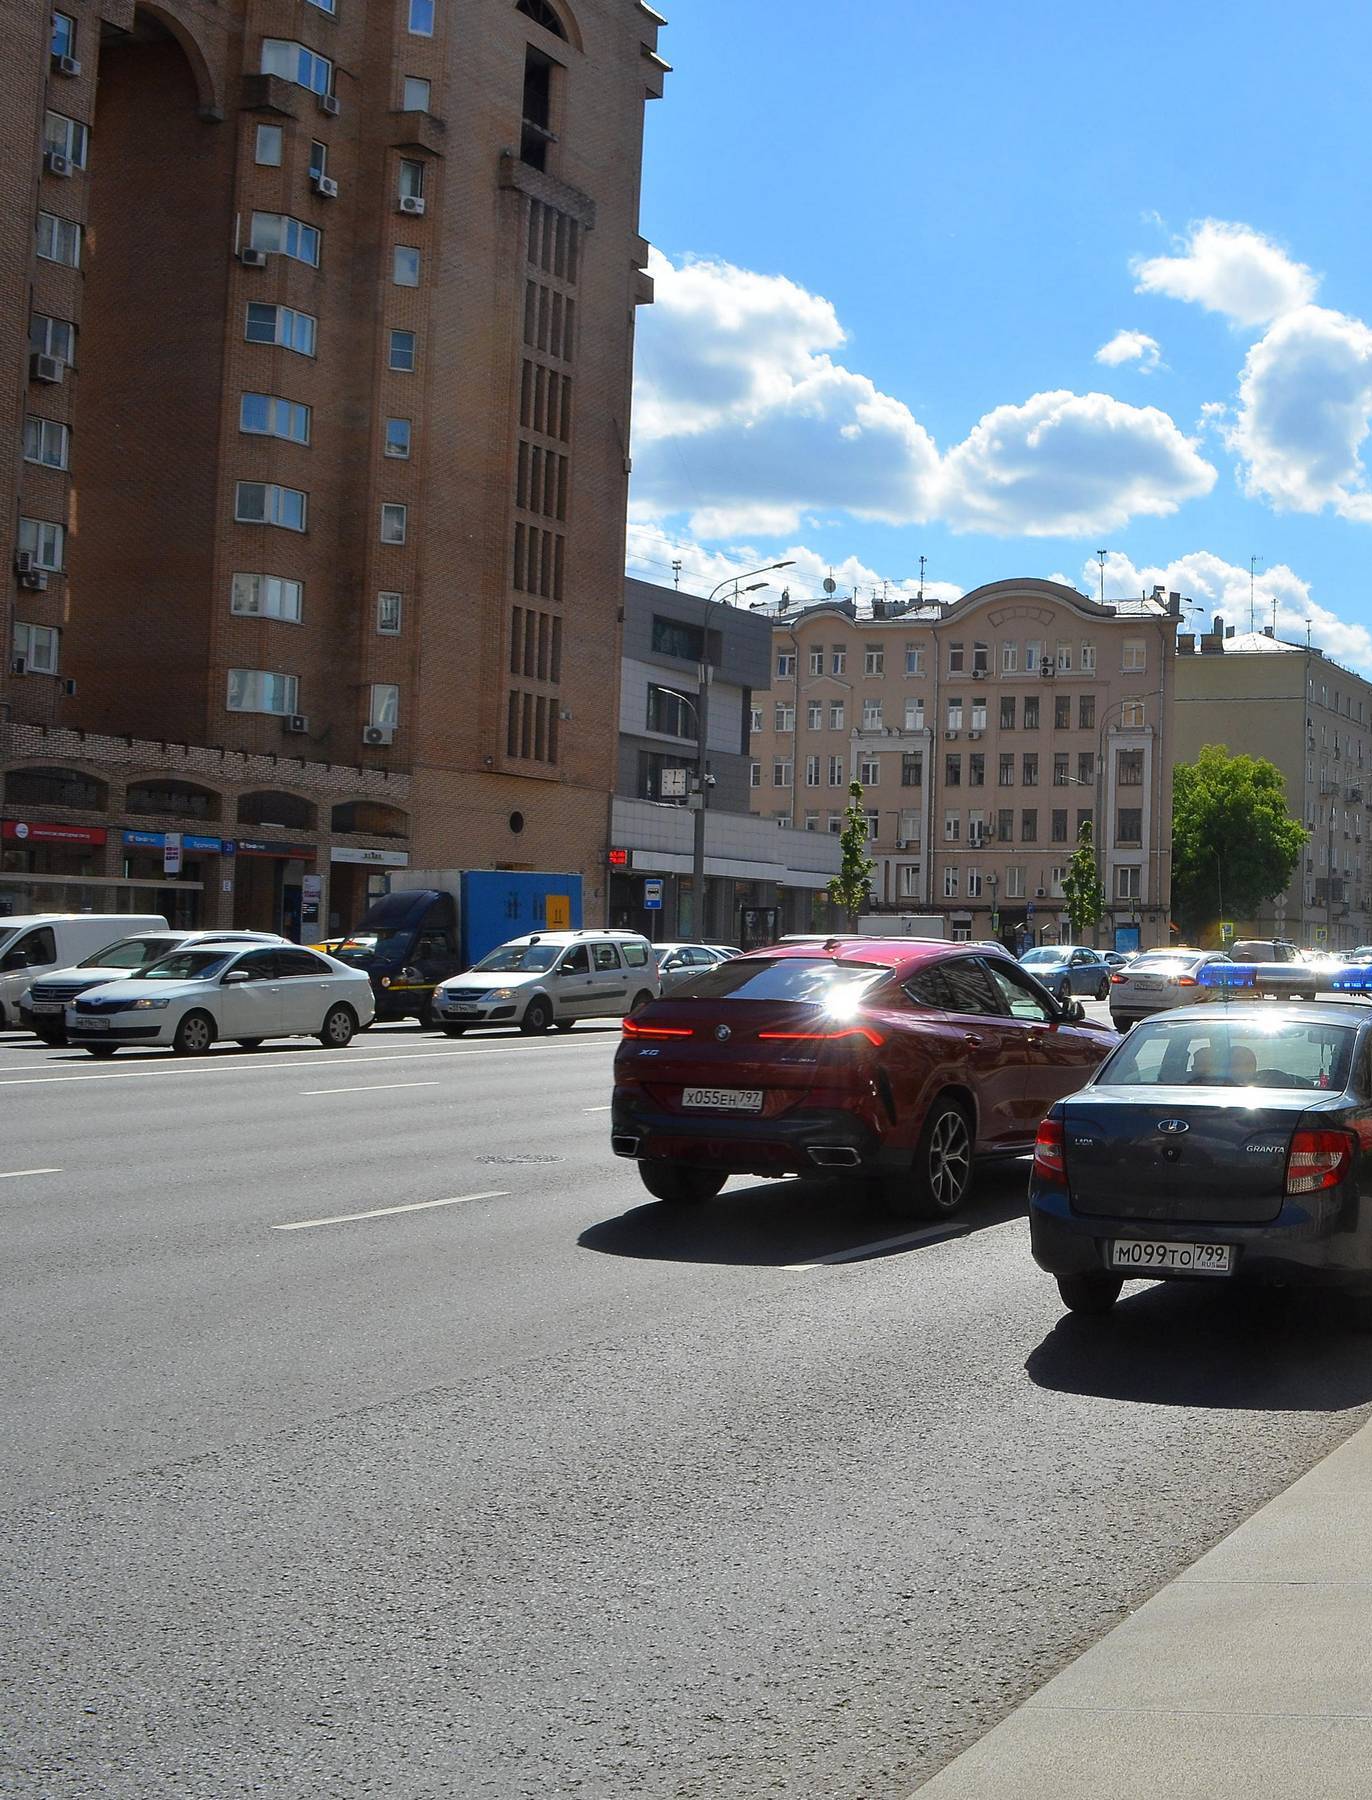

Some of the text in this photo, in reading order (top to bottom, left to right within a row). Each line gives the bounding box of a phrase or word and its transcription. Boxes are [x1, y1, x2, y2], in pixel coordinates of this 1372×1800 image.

[1246, 1145, 1286, 1154] GRANTA
[1117, 1243, 1225, 1266] М099ТО 799
